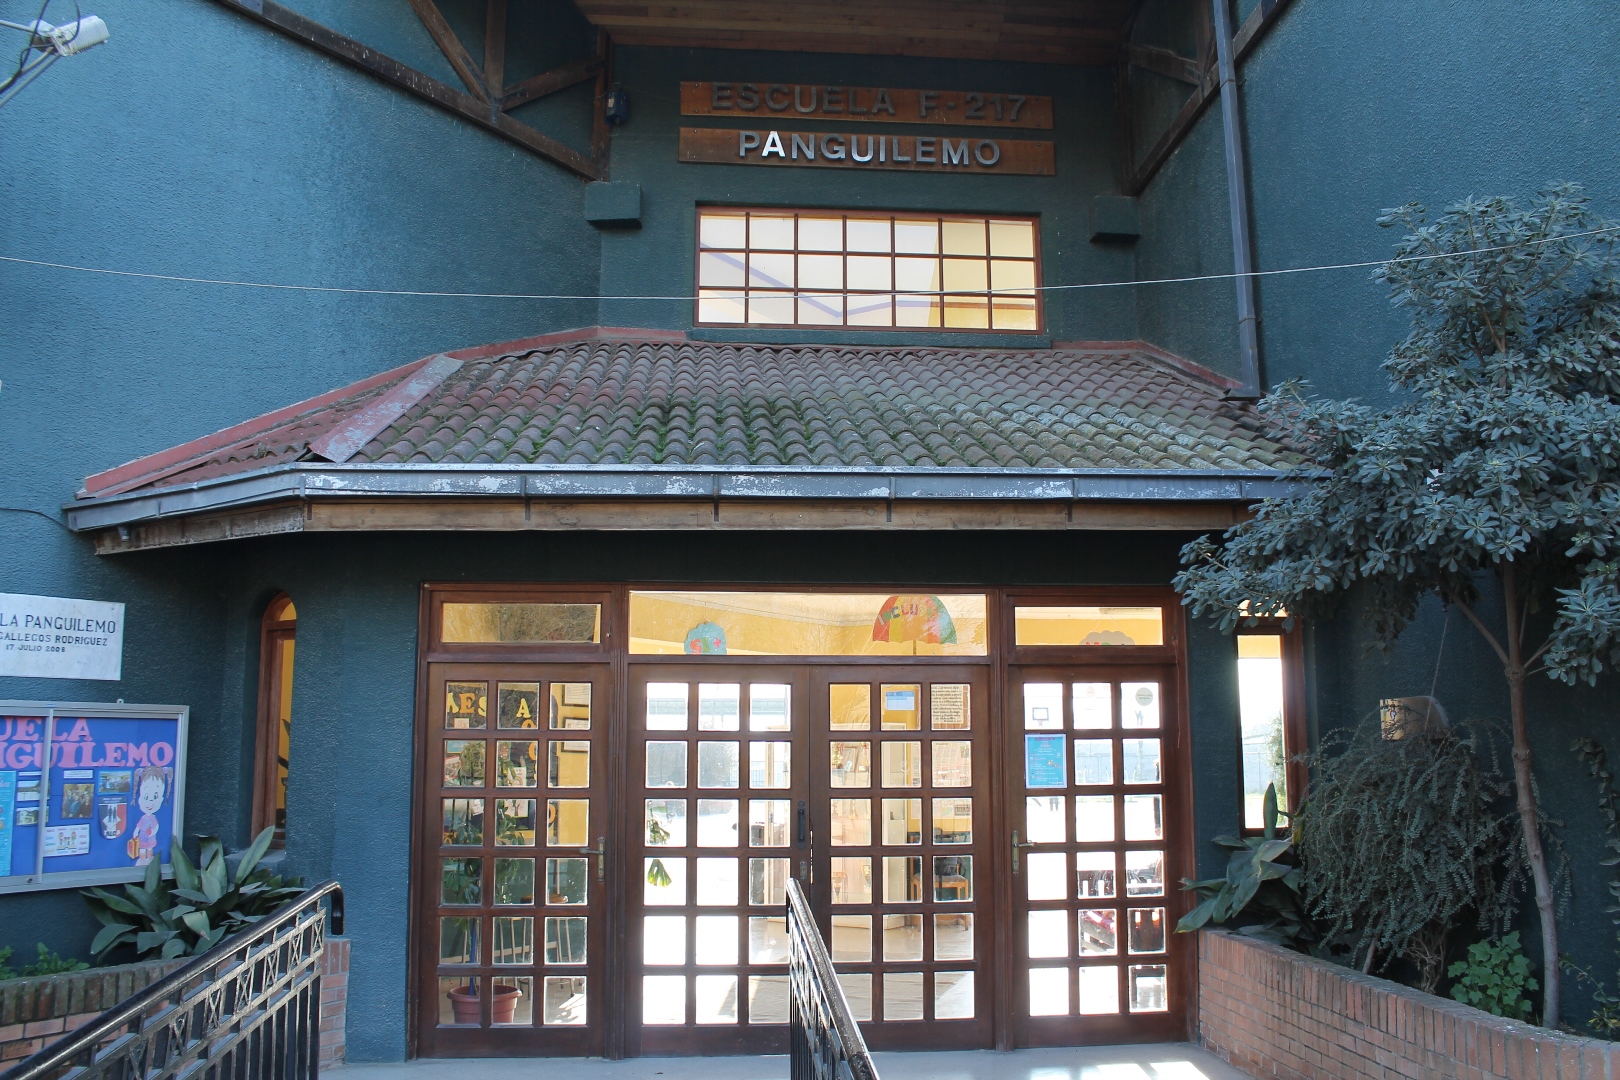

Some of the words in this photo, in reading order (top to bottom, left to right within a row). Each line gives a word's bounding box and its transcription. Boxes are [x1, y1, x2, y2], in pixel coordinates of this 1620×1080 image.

[711, 82, 895, 115] ESCUELA
[738, 130, 1000, 166] PANGUILEMO
[25, 614, 116, 634] PANGUILEMO
[6, 643, 15, 651] 17
[18, 644, 42, 652] JULIO
[55, 635, 108, 647] RODRIGUEZ
